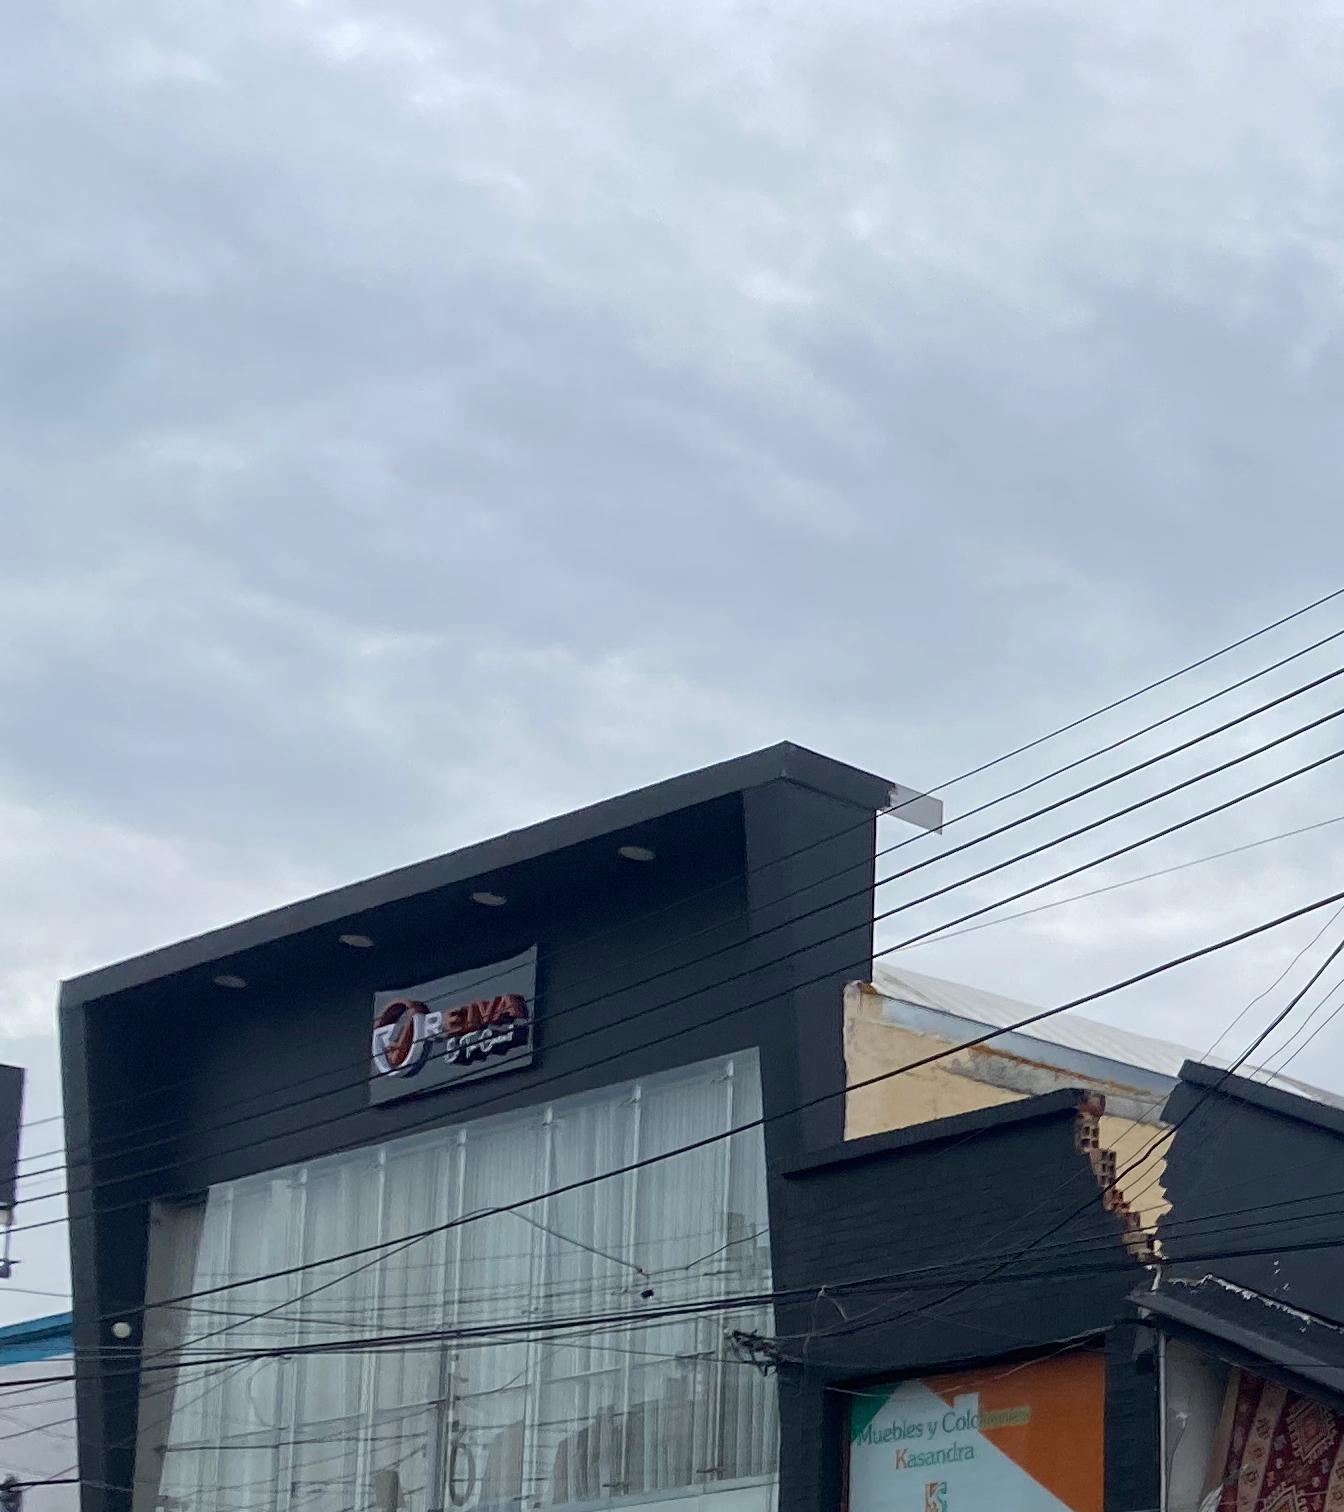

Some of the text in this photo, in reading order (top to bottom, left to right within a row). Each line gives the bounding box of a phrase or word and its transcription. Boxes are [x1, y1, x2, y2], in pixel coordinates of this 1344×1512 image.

[856, 1420, 923, 1446] Muebles
[928, 1420, 938, 1440] y
[896, 1441, 975, 1470] Kasandra
